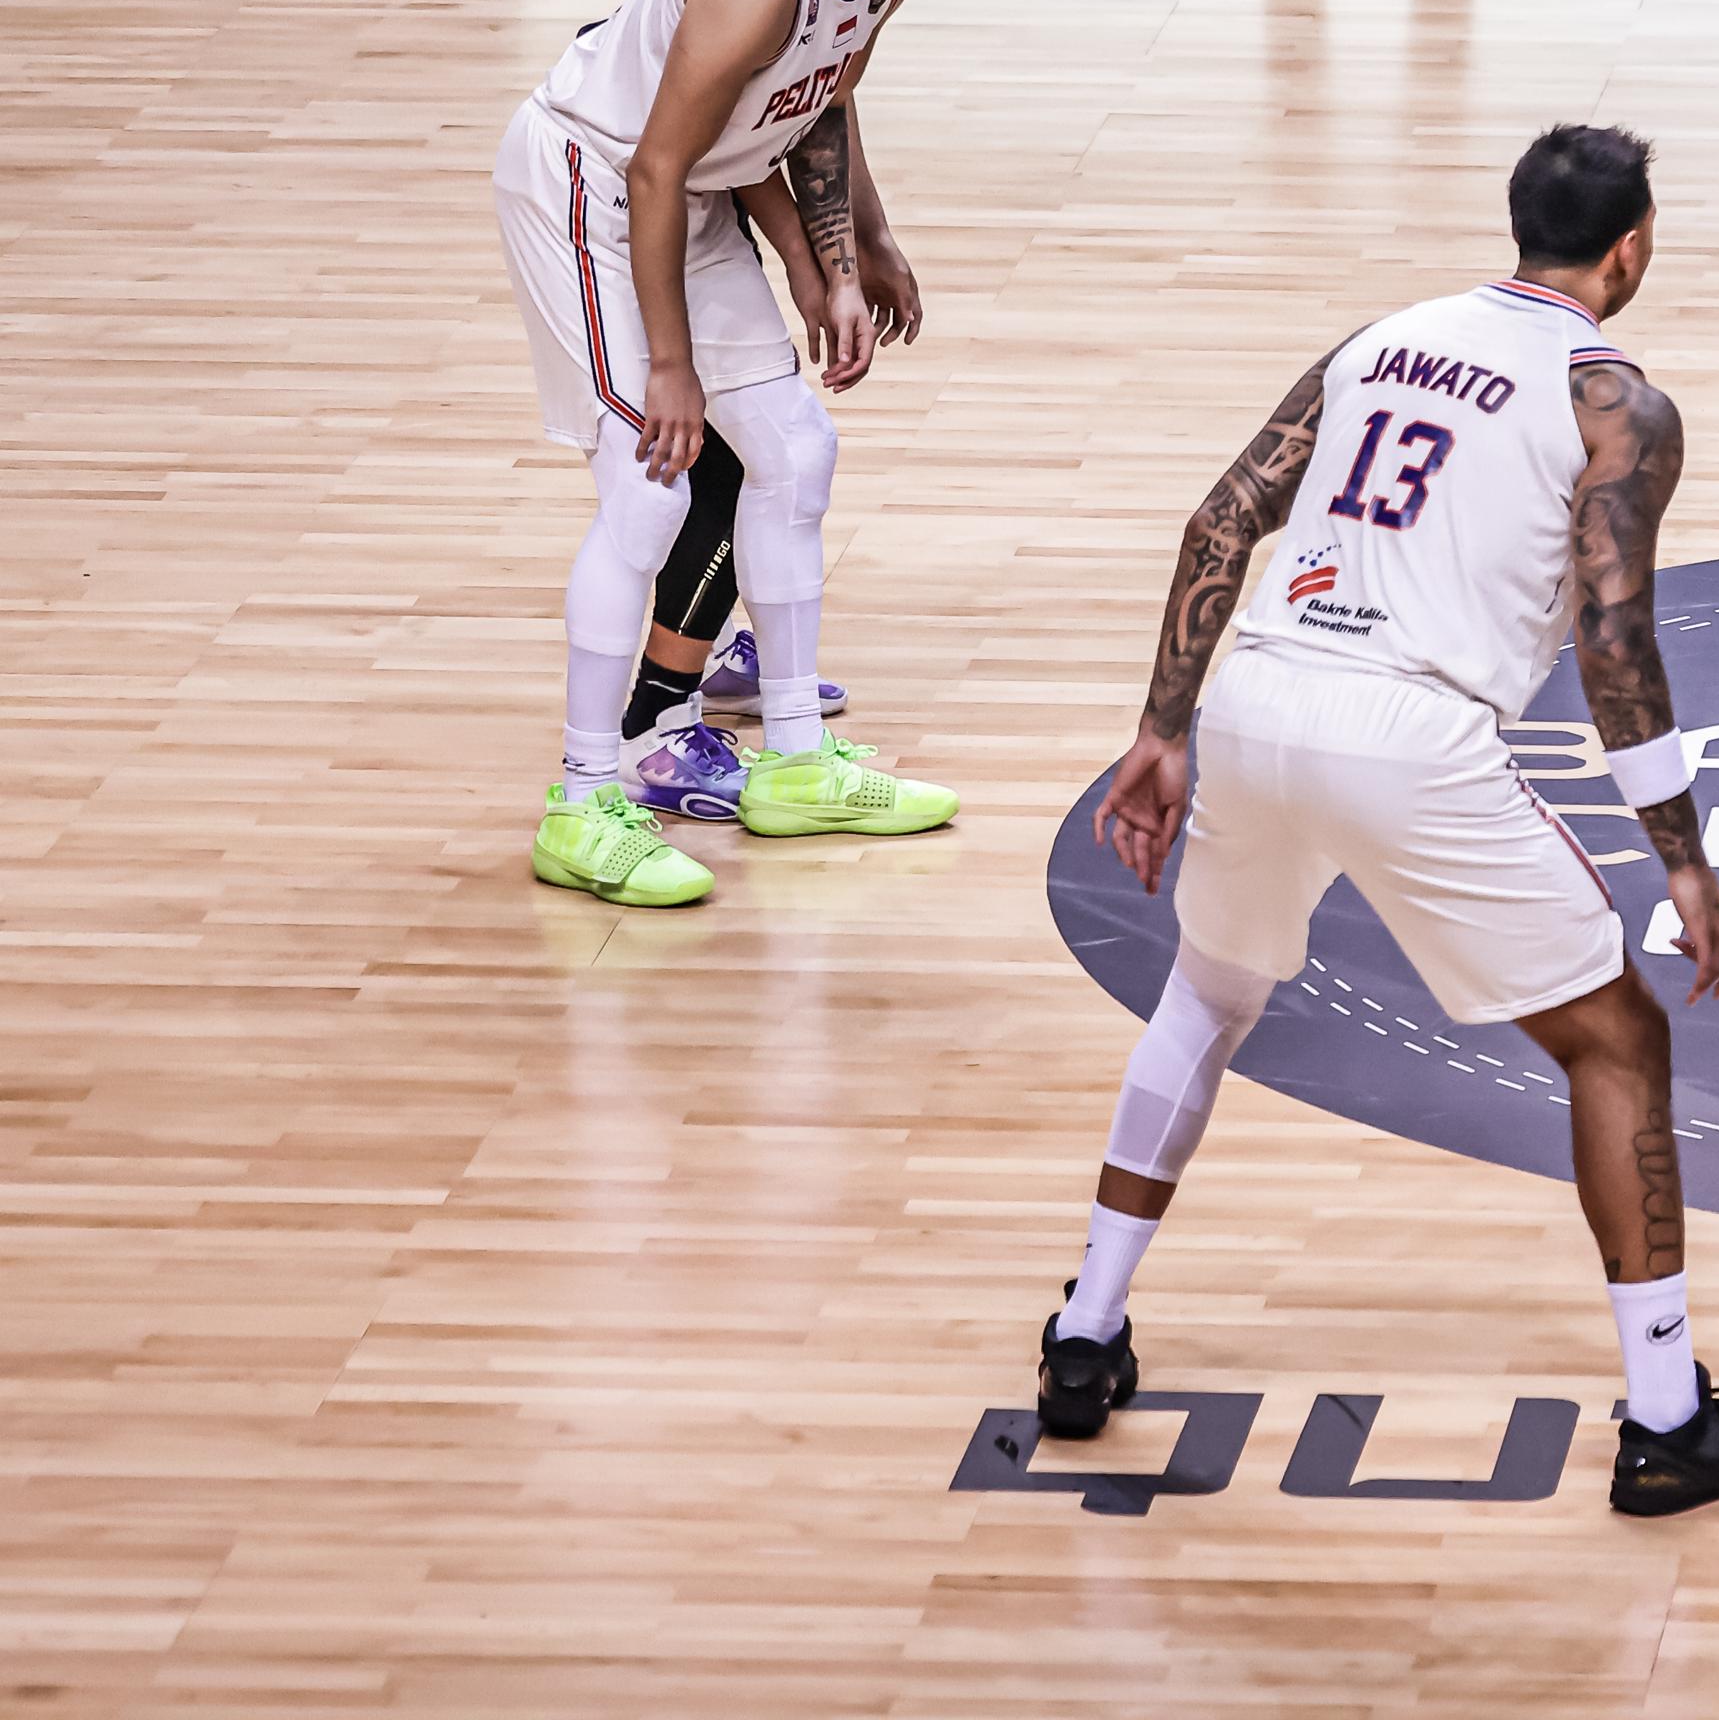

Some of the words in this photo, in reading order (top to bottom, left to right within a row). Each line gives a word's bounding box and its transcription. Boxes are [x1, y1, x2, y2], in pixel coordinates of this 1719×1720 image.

[1360, 346, 1516, 415] JAWATO
[1327, 408, 1457, 532] 13
[1298, 611, 1374, 638] Investment
[1306, 598, 1352, 619] Bakrie
